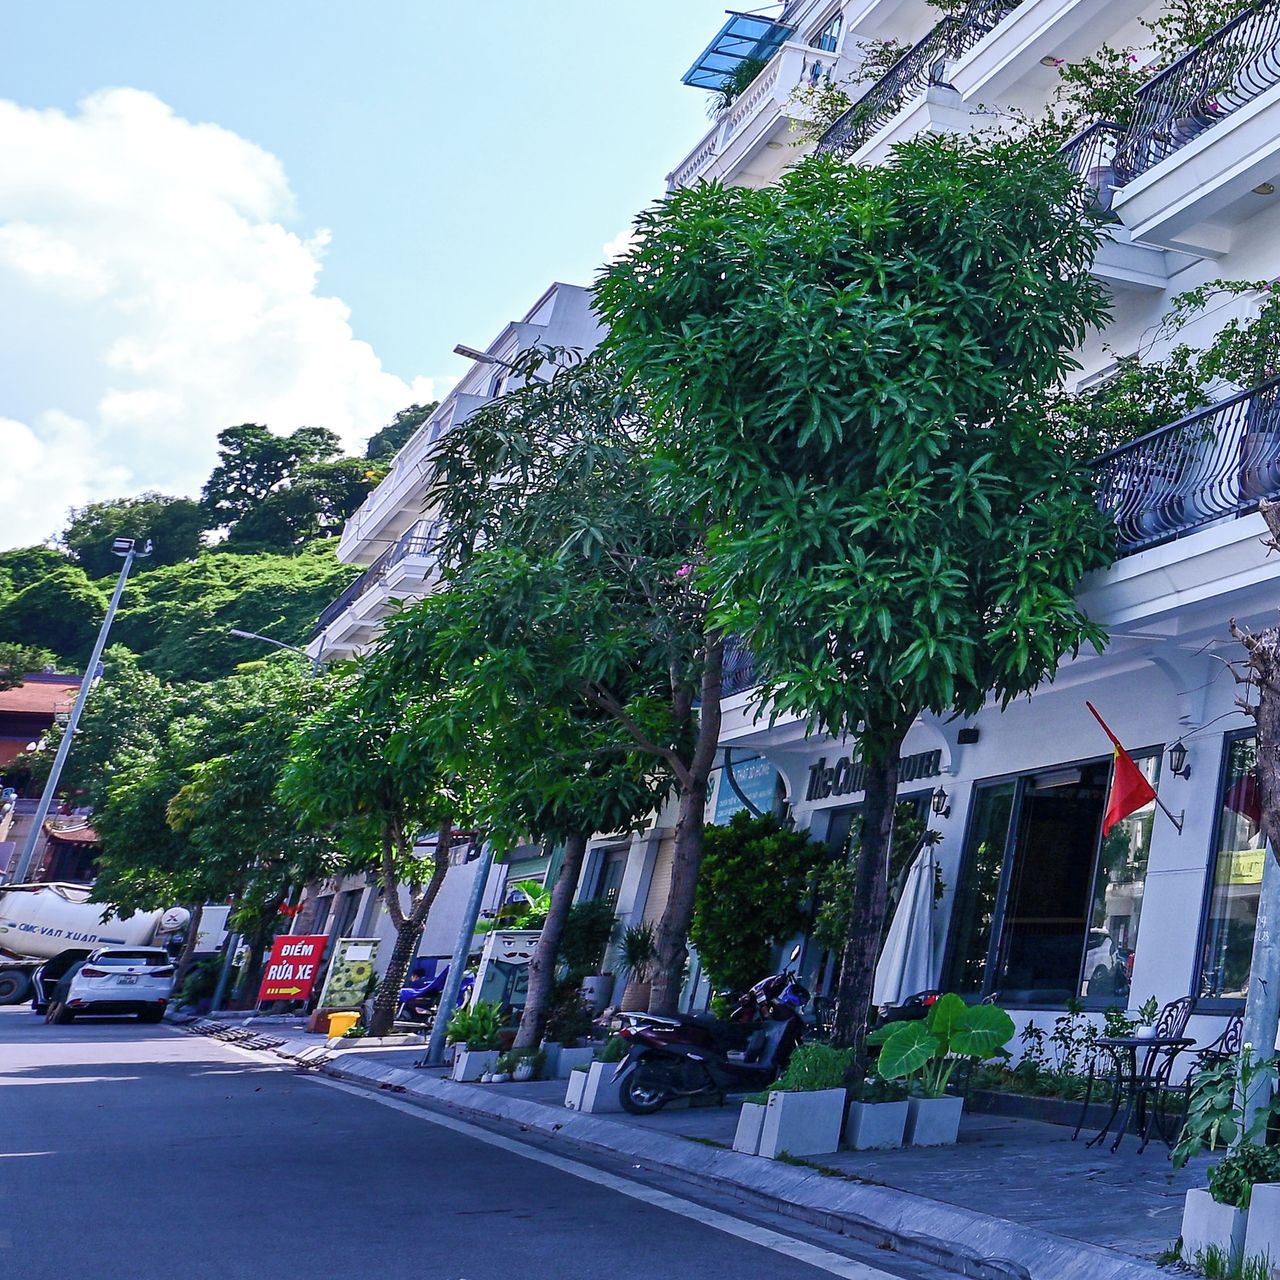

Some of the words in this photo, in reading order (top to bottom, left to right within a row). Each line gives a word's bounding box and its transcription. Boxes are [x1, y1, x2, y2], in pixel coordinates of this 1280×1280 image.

[805, 756, 834, 802] The
[281, 940, 314, 956] ĐIỂM
[267, 960, 293, 980] RỬA
[295, 965, 314, 979] XE
